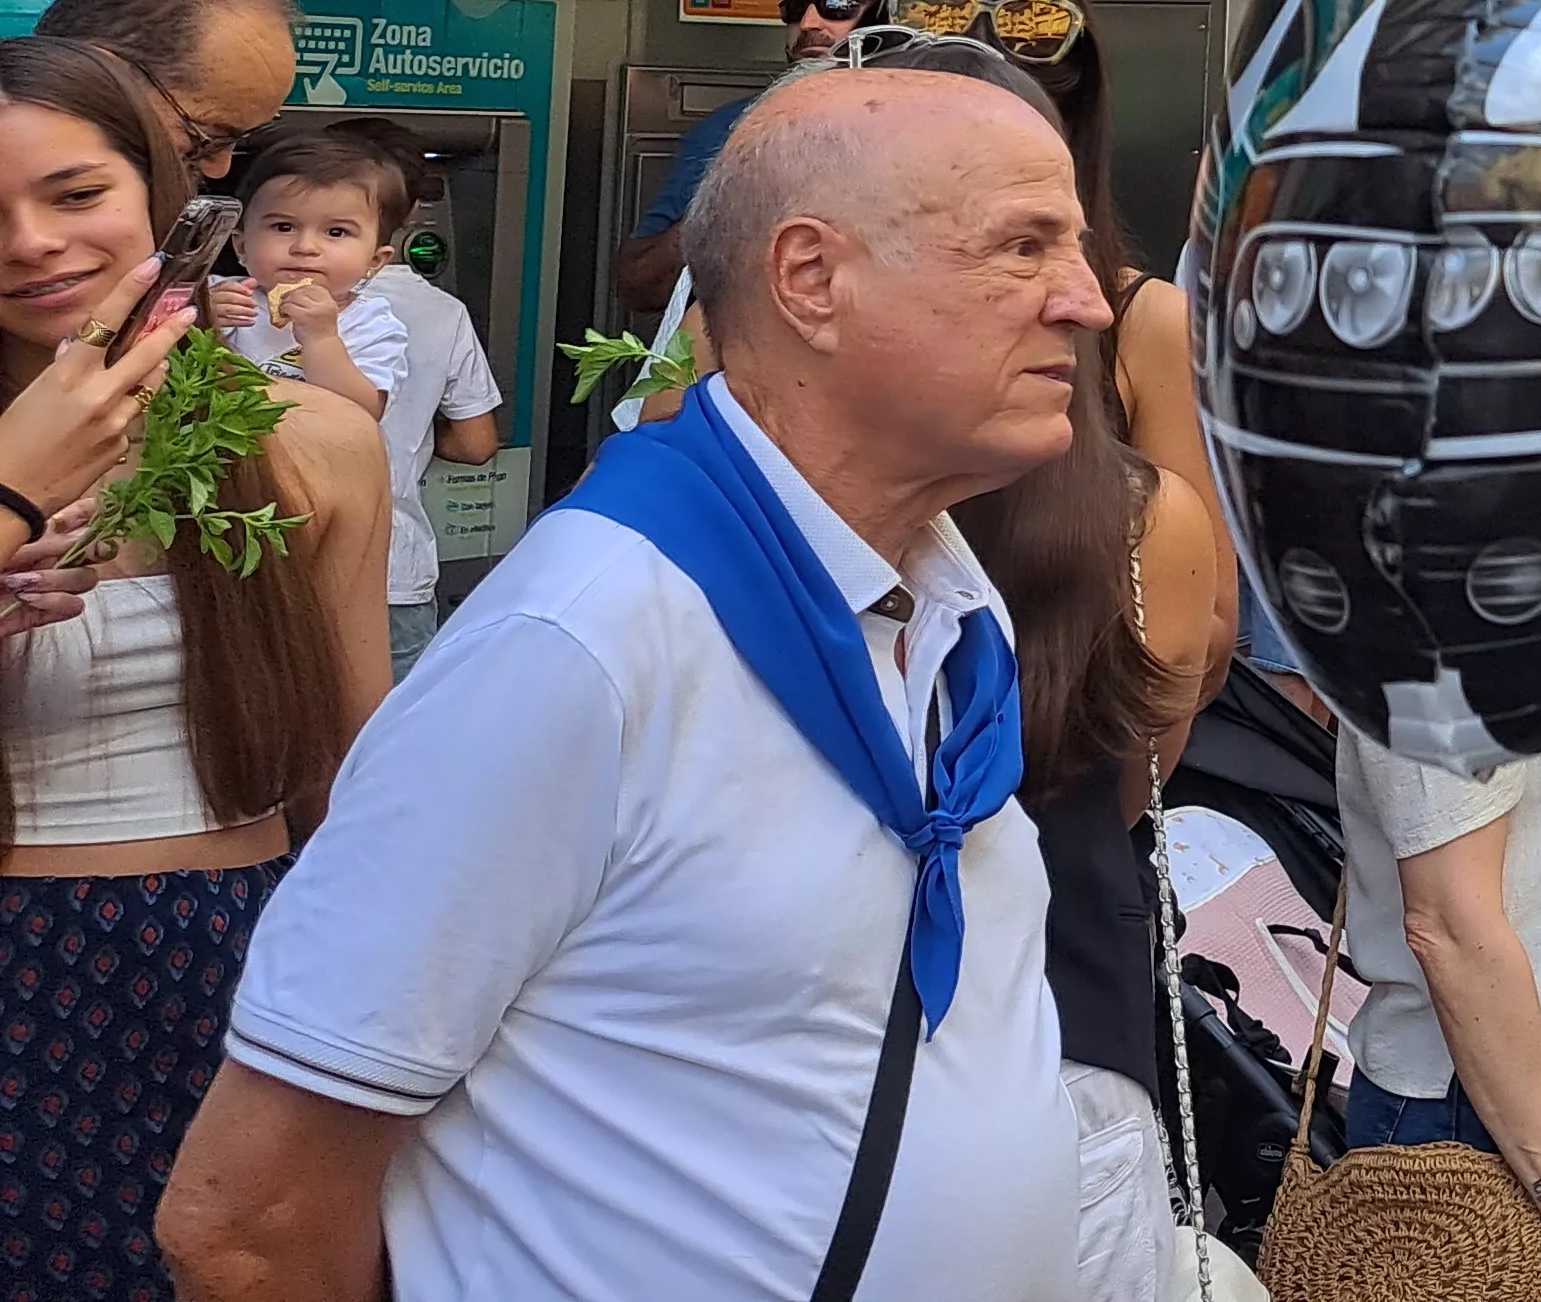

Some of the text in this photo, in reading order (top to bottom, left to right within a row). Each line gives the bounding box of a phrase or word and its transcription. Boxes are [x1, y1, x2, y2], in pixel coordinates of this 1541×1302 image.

[369, 18, 433, 47] Zona
[368, 48, 526, 80] Autoservicio
[366, 78, 463, 95] Self-service Area
